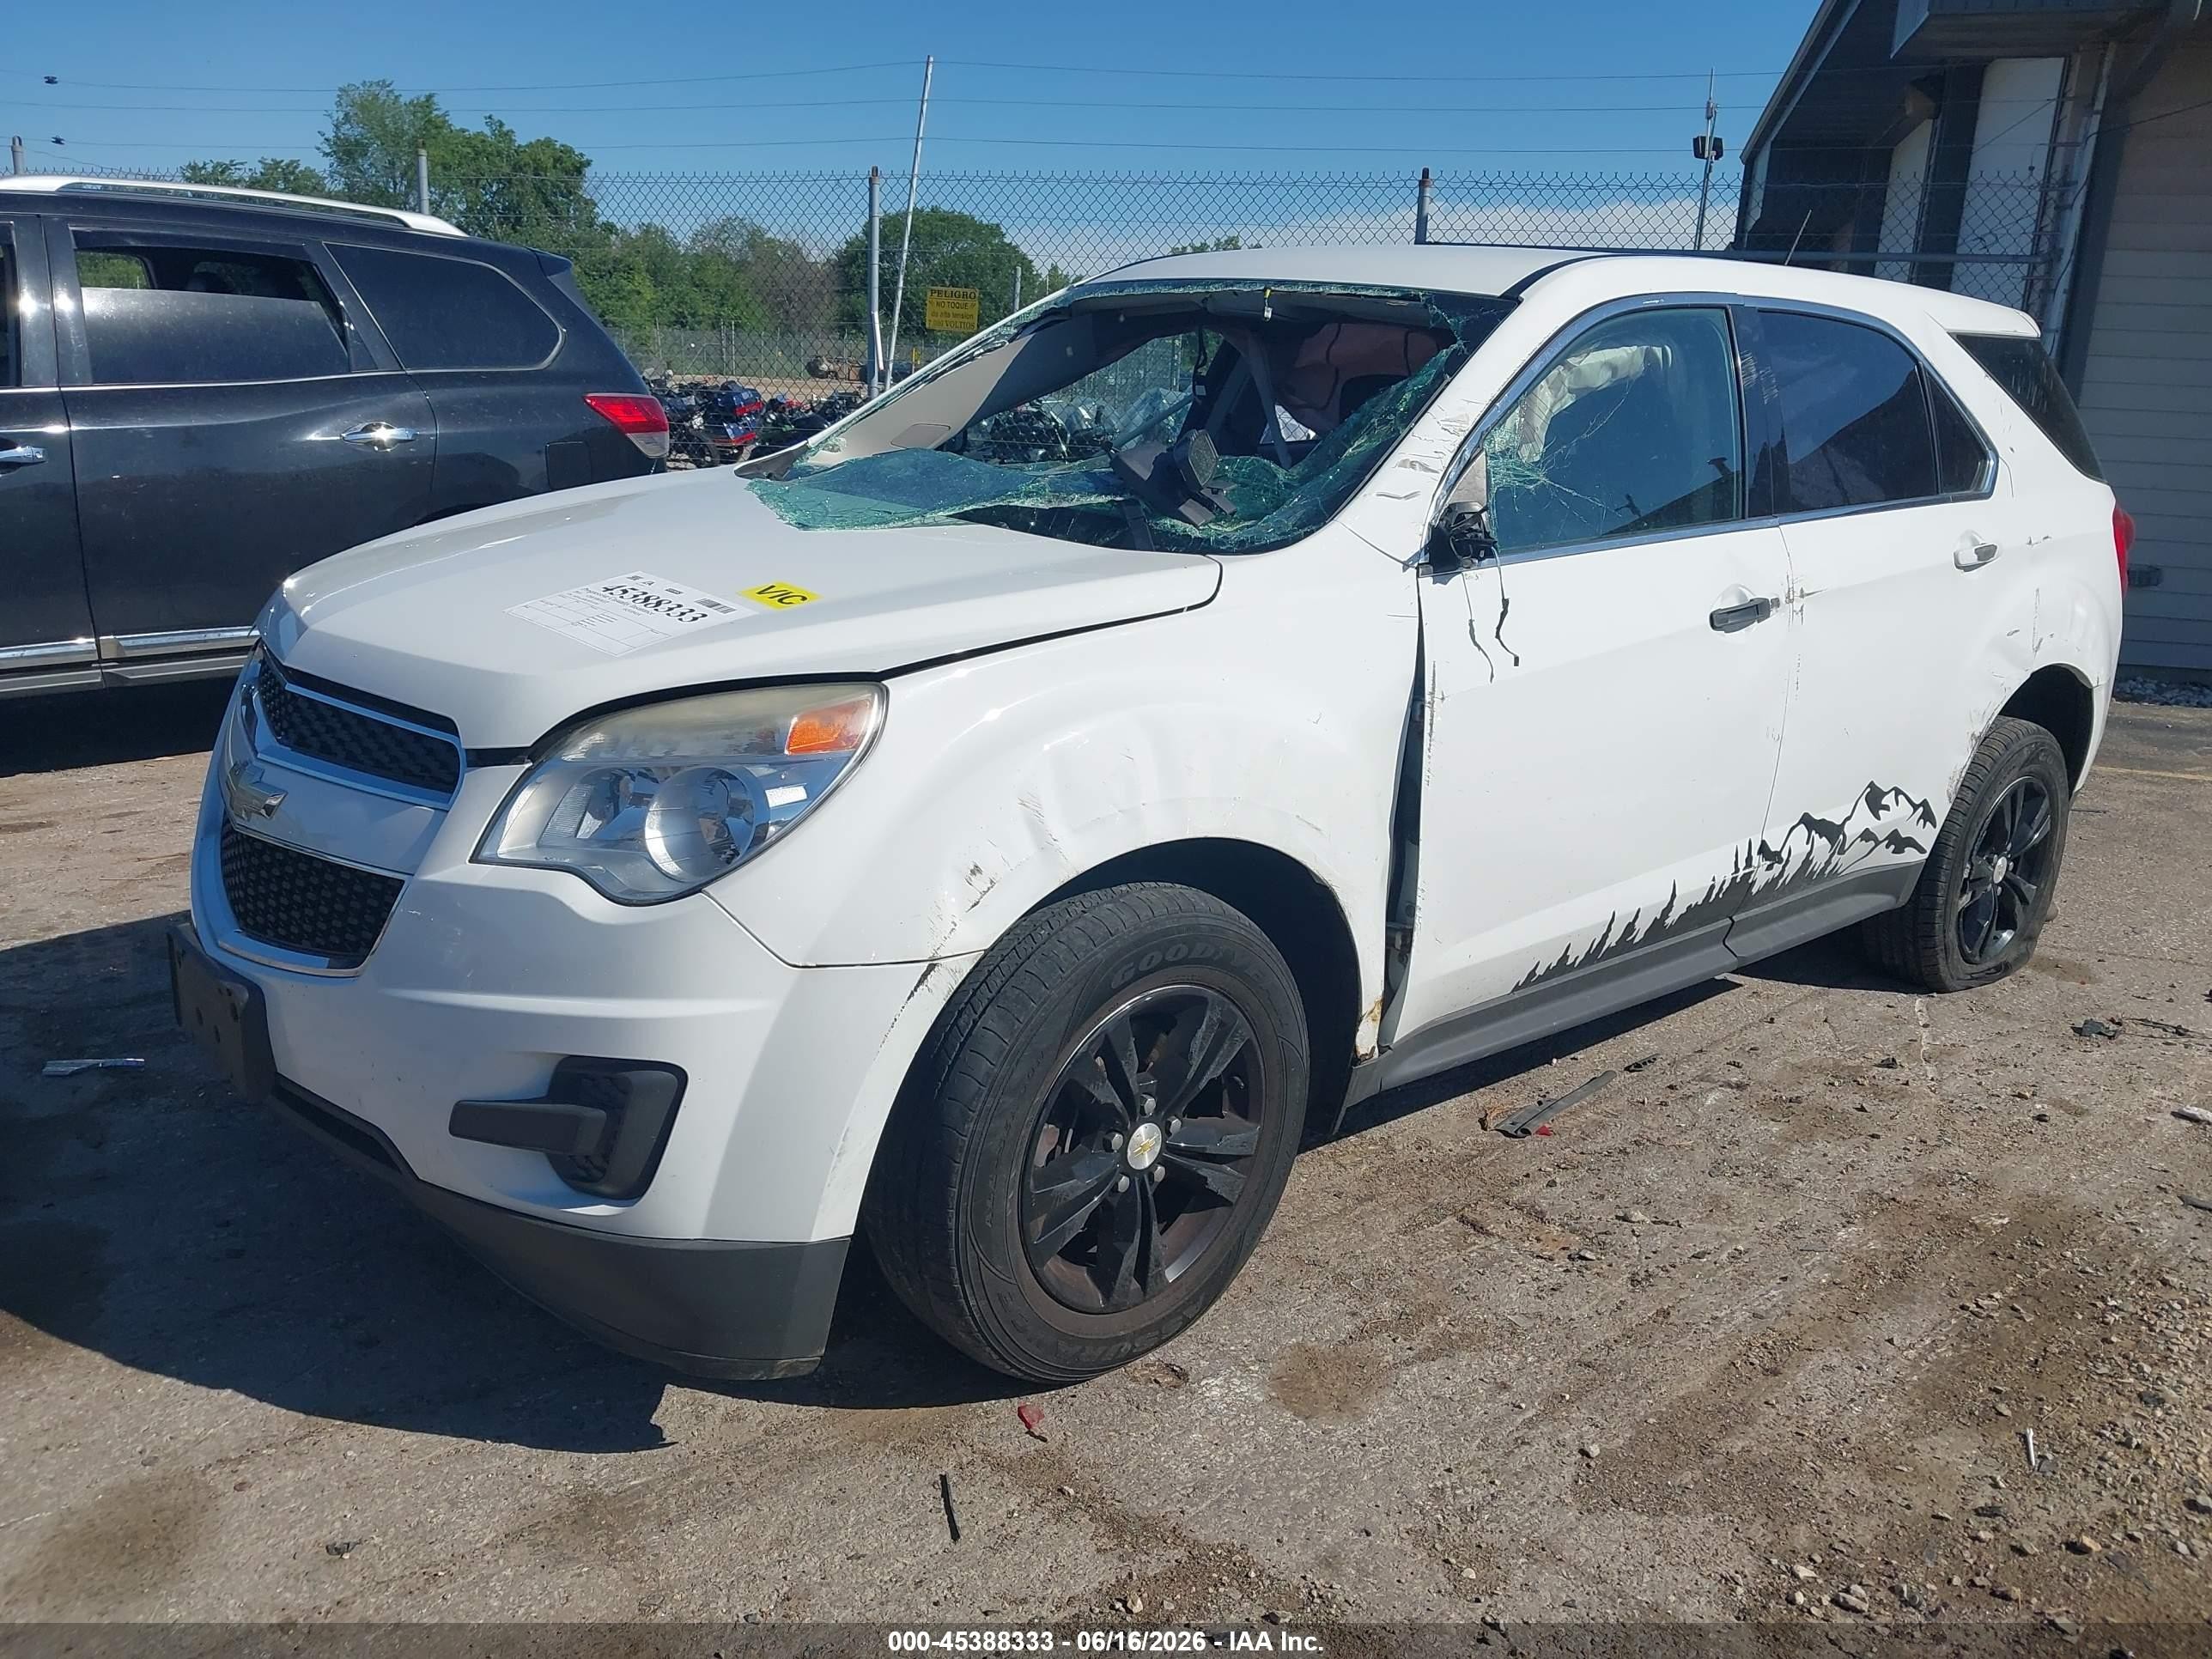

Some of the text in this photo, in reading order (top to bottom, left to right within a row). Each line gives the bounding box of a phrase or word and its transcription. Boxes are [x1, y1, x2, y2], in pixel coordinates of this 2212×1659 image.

[930, 289, 976, 300] PELIGRO
[947, 301, 969, 310] TOQUE
[756, 585, 808, 605] VIC
[601, 585, 708, 623] 45388333
